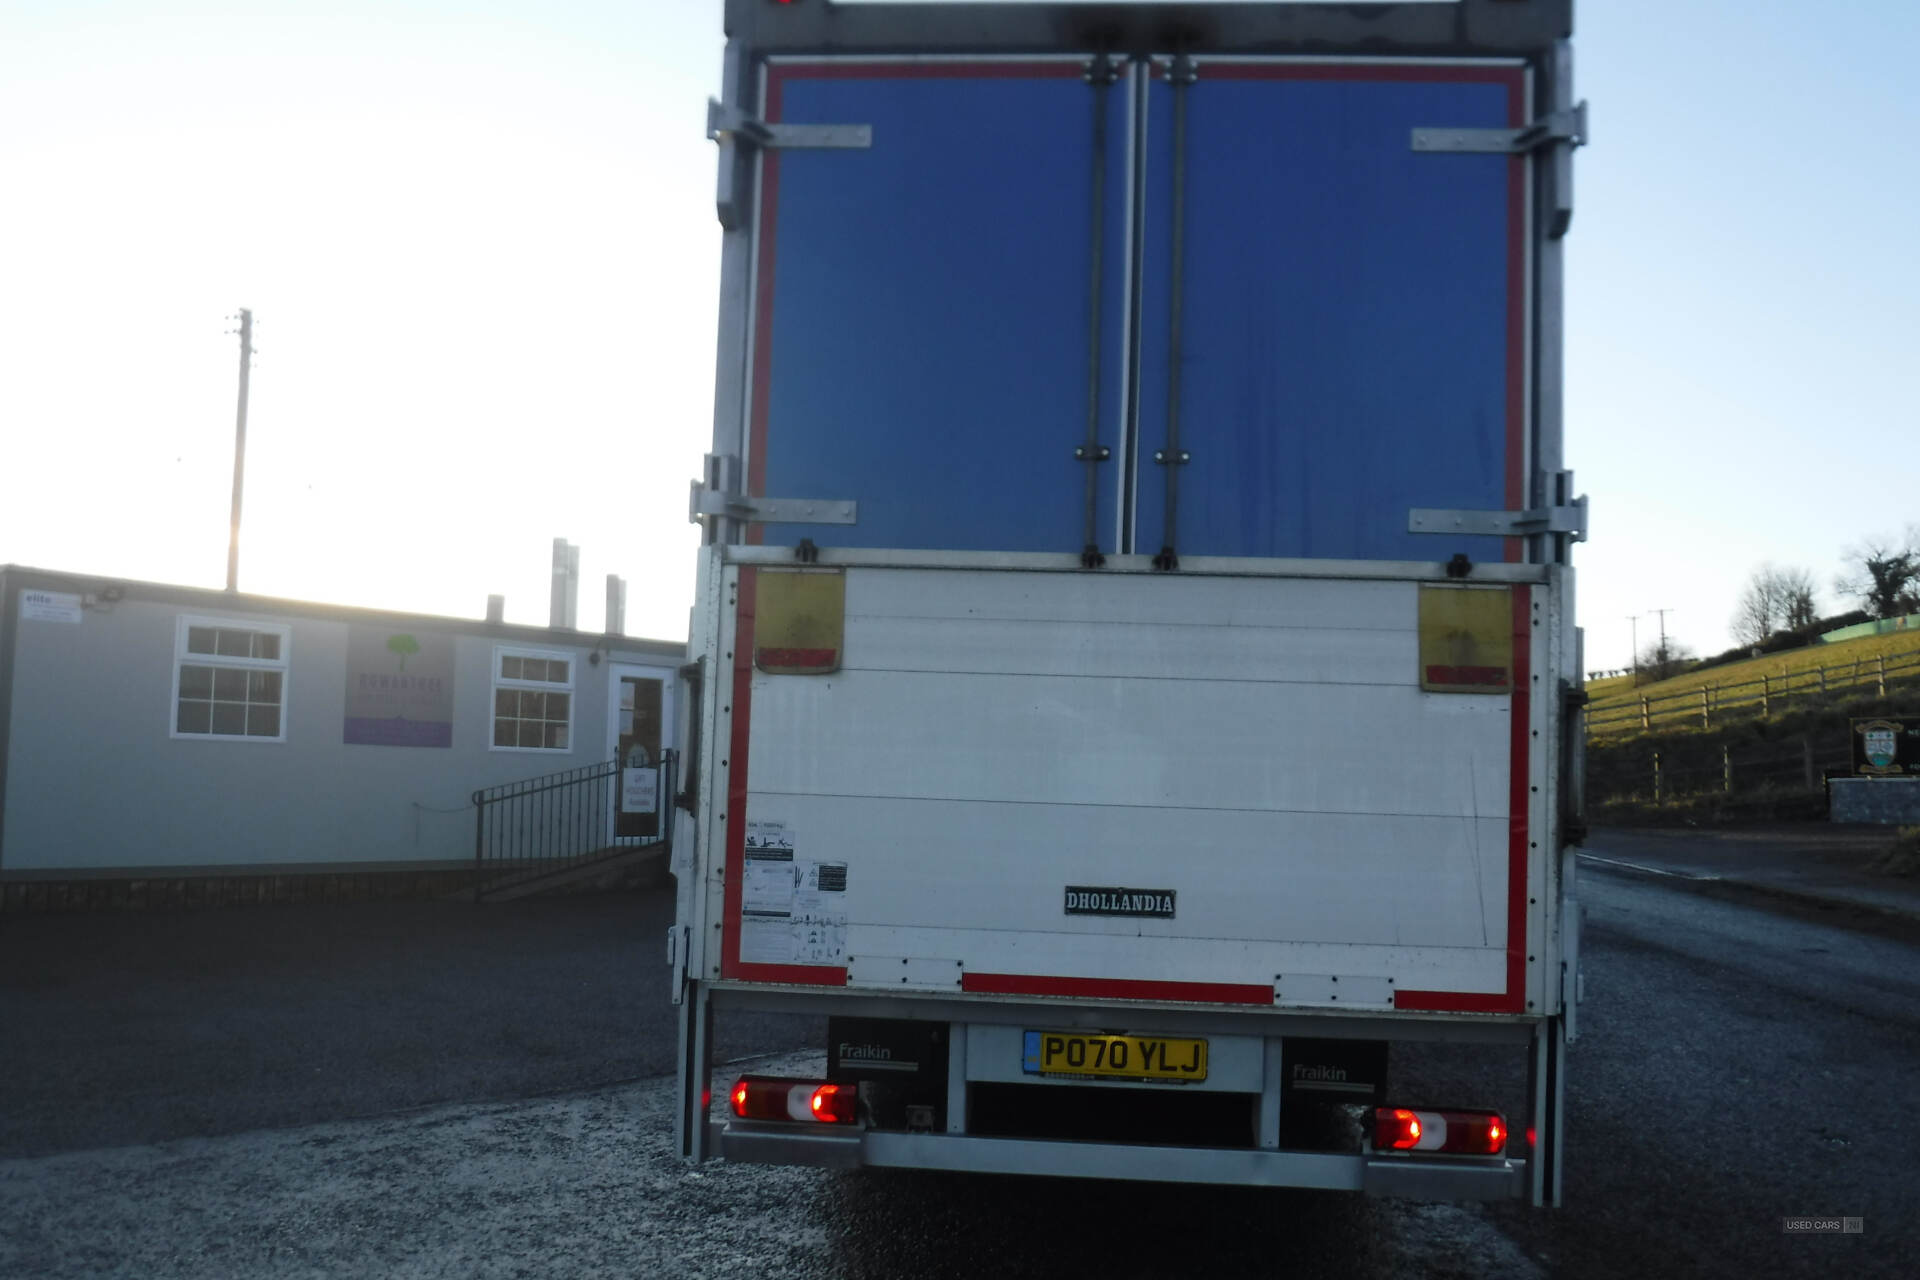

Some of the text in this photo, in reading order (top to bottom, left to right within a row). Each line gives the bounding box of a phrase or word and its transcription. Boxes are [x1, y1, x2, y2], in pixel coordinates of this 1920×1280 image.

[1067, 892, 1173, 912] DHOLLANDIA
[839, 1043, 891, 1059] Fraikin
[1045, 1037, 1199, 1072] PO70 YLJ
[1293, 1064, 1346, 1081] Fraikin
